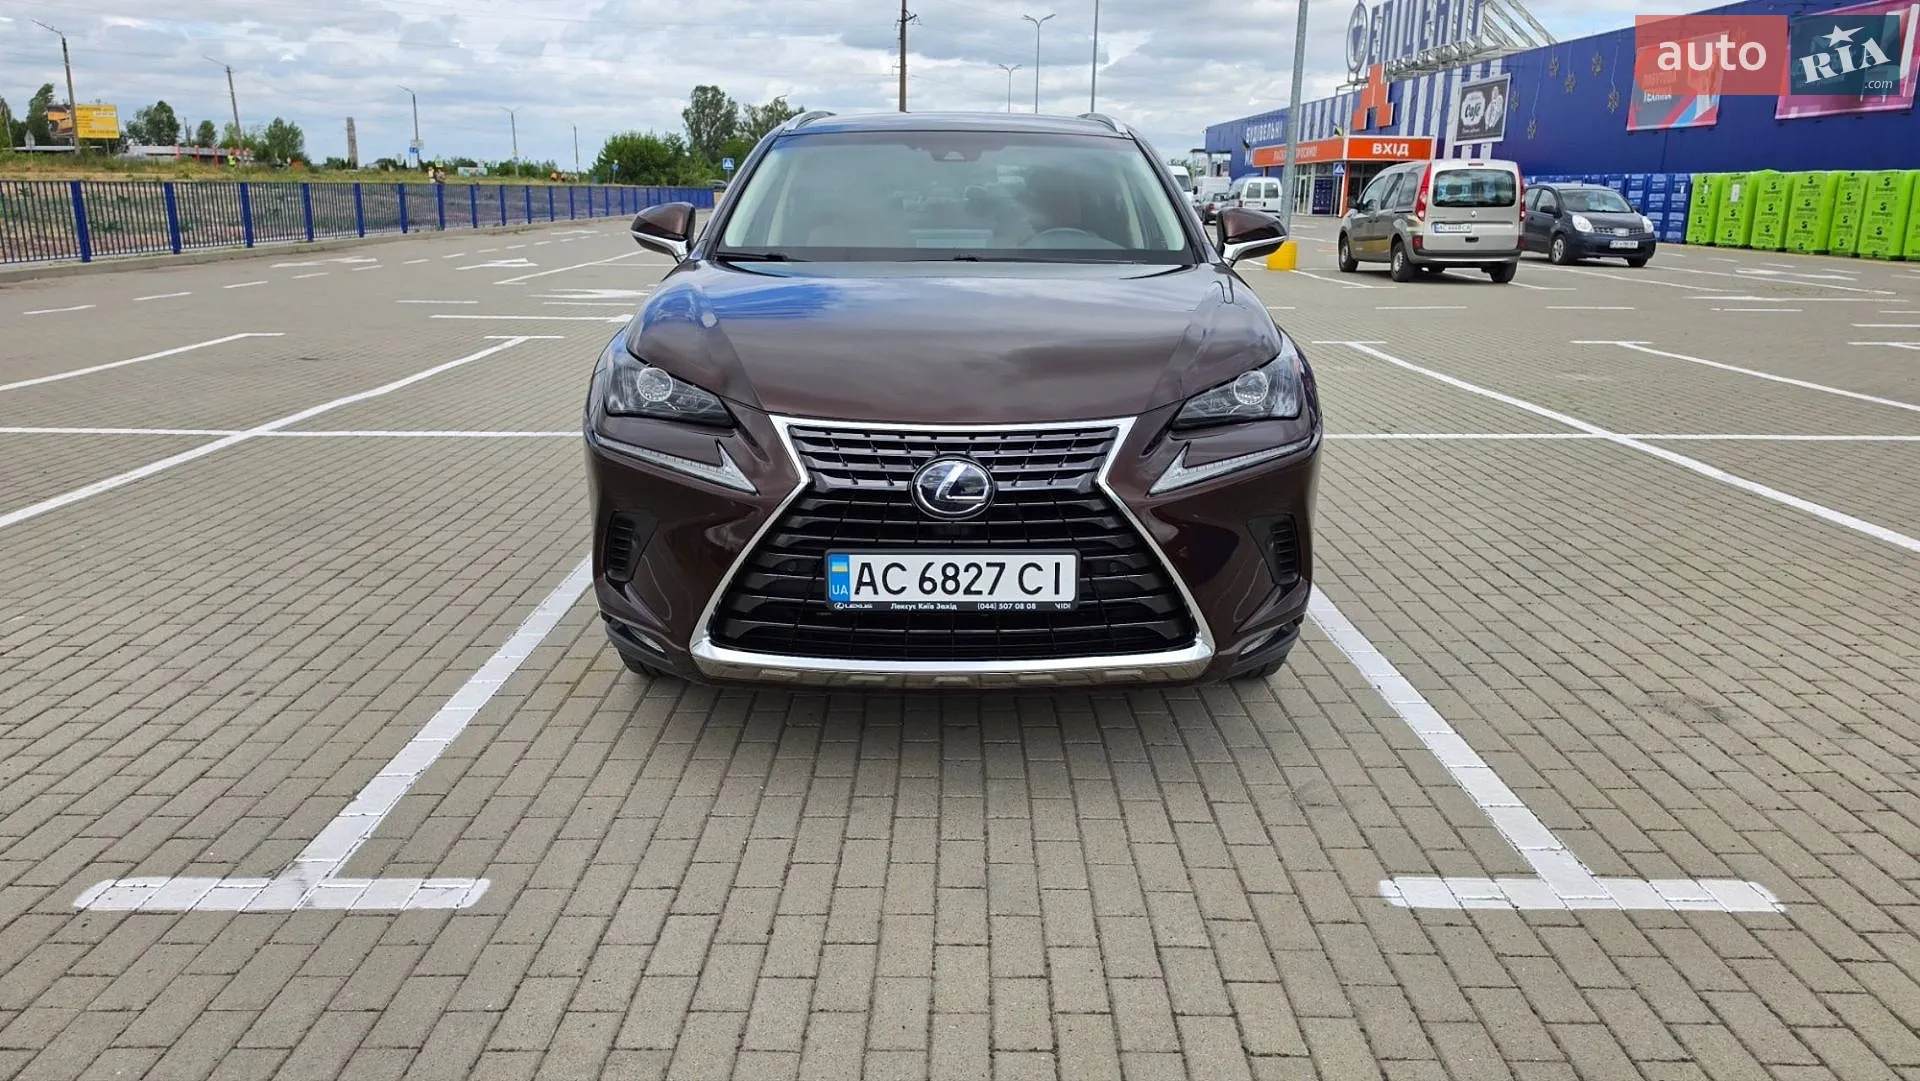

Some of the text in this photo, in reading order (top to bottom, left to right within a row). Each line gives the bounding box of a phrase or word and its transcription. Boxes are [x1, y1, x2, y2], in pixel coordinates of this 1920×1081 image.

[1372, 142, 1409, 157] ВХІД
[854, 562, 1060, 595] AC 6827 CI
[832, 585, 849, 595] UA
